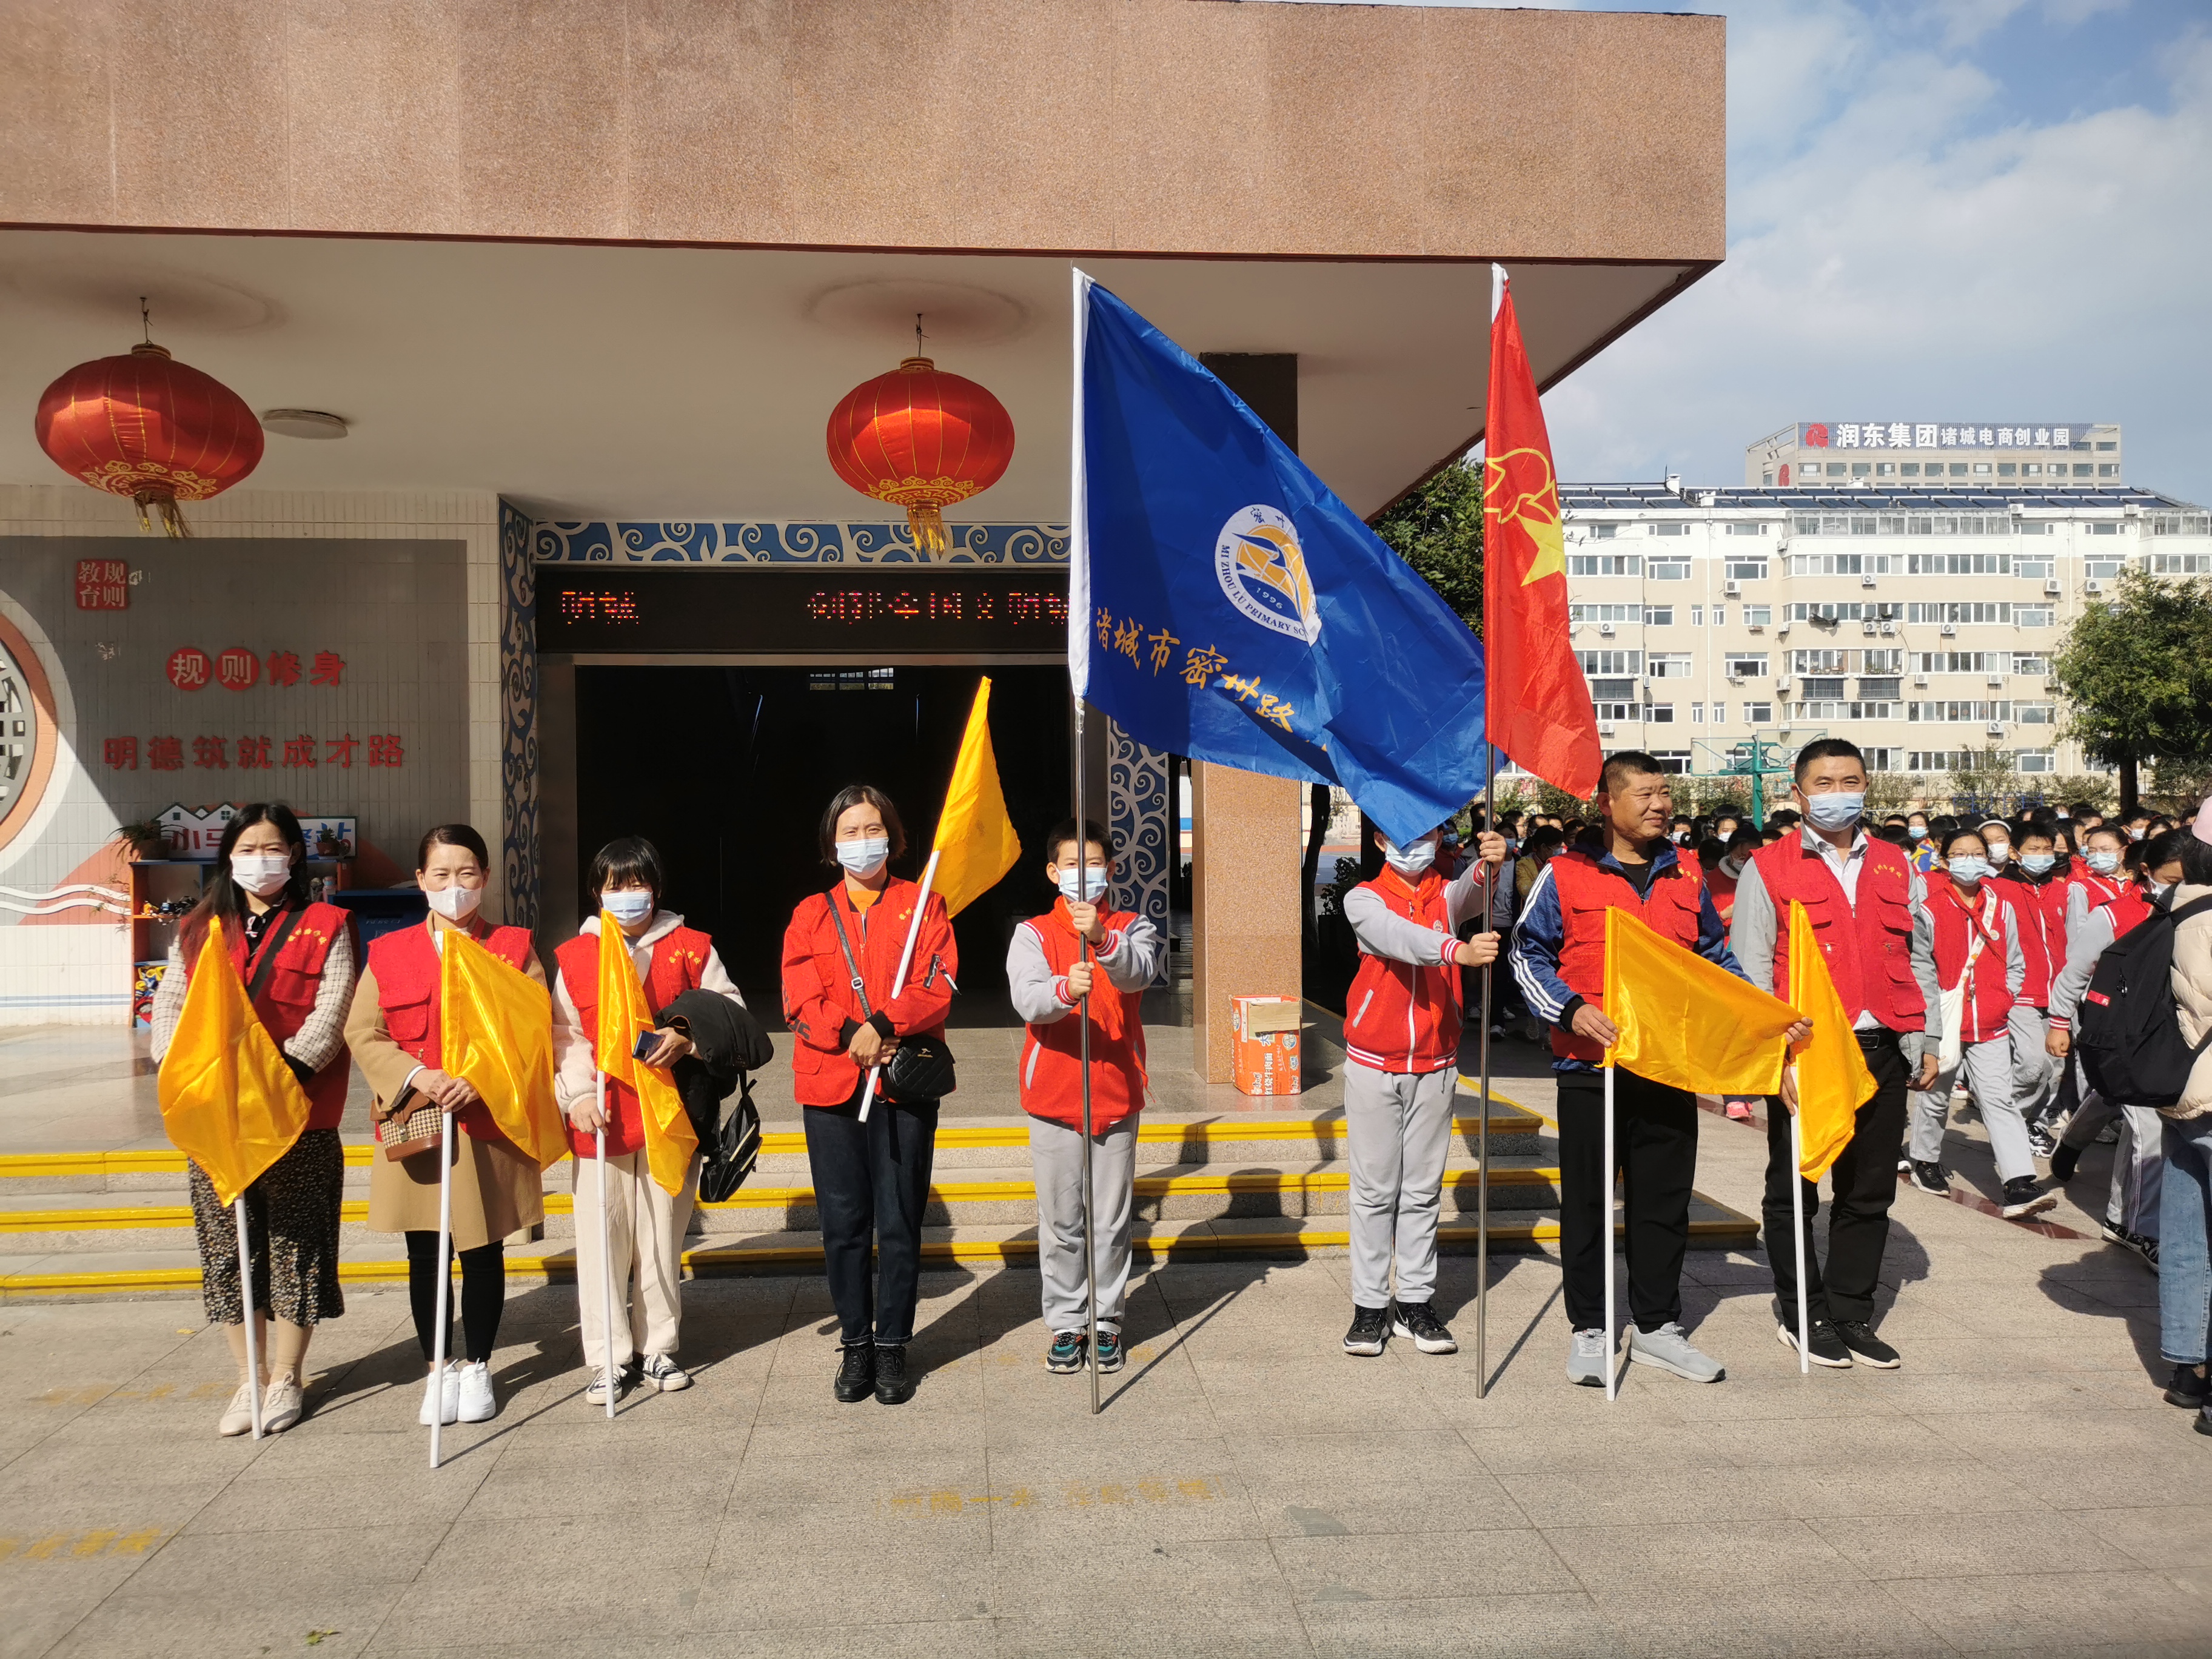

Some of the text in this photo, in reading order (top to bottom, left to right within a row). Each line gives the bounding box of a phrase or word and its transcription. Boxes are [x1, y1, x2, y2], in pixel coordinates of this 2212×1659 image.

[1837, 423, 2069, 448] 润东集团 诸城电商创业园
[1221, 545, 1230, 558] MI
[1221, 561, 1237, 589] ZHOU
[1233, 591, 1247, 604] LU
[1256, 587, 1284, 609] 1996
[1245, 603, 1292, 631] PRIMARY
[172, 650, 345, 686] 规则修身
[104, 734, 404, 771] 明德筑就成才路
[1264, 1053, 1273, 1095] 红烧牛肉面
